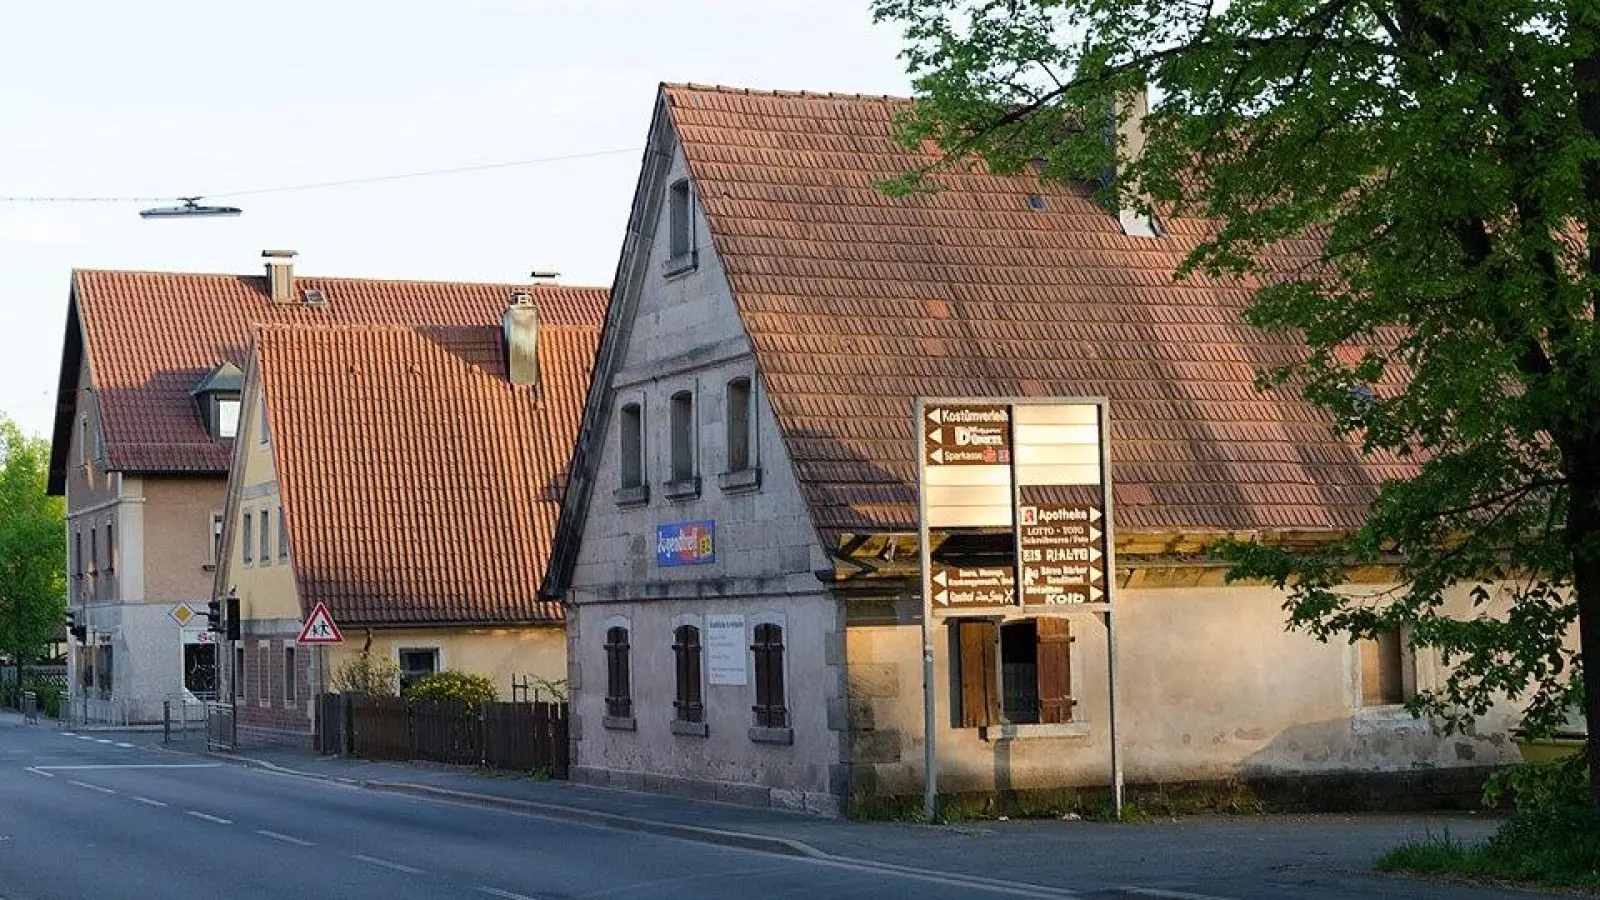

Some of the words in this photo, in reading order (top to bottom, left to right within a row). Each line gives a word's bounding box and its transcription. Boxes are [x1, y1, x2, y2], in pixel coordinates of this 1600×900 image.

[1039, 508, 1088, 523] Apotheke
[1027, 526, 1054, 536] LOTTO
[1022, 549, 1042, 561] EIS
[1046, 548, 1089, 562] RIALTO
